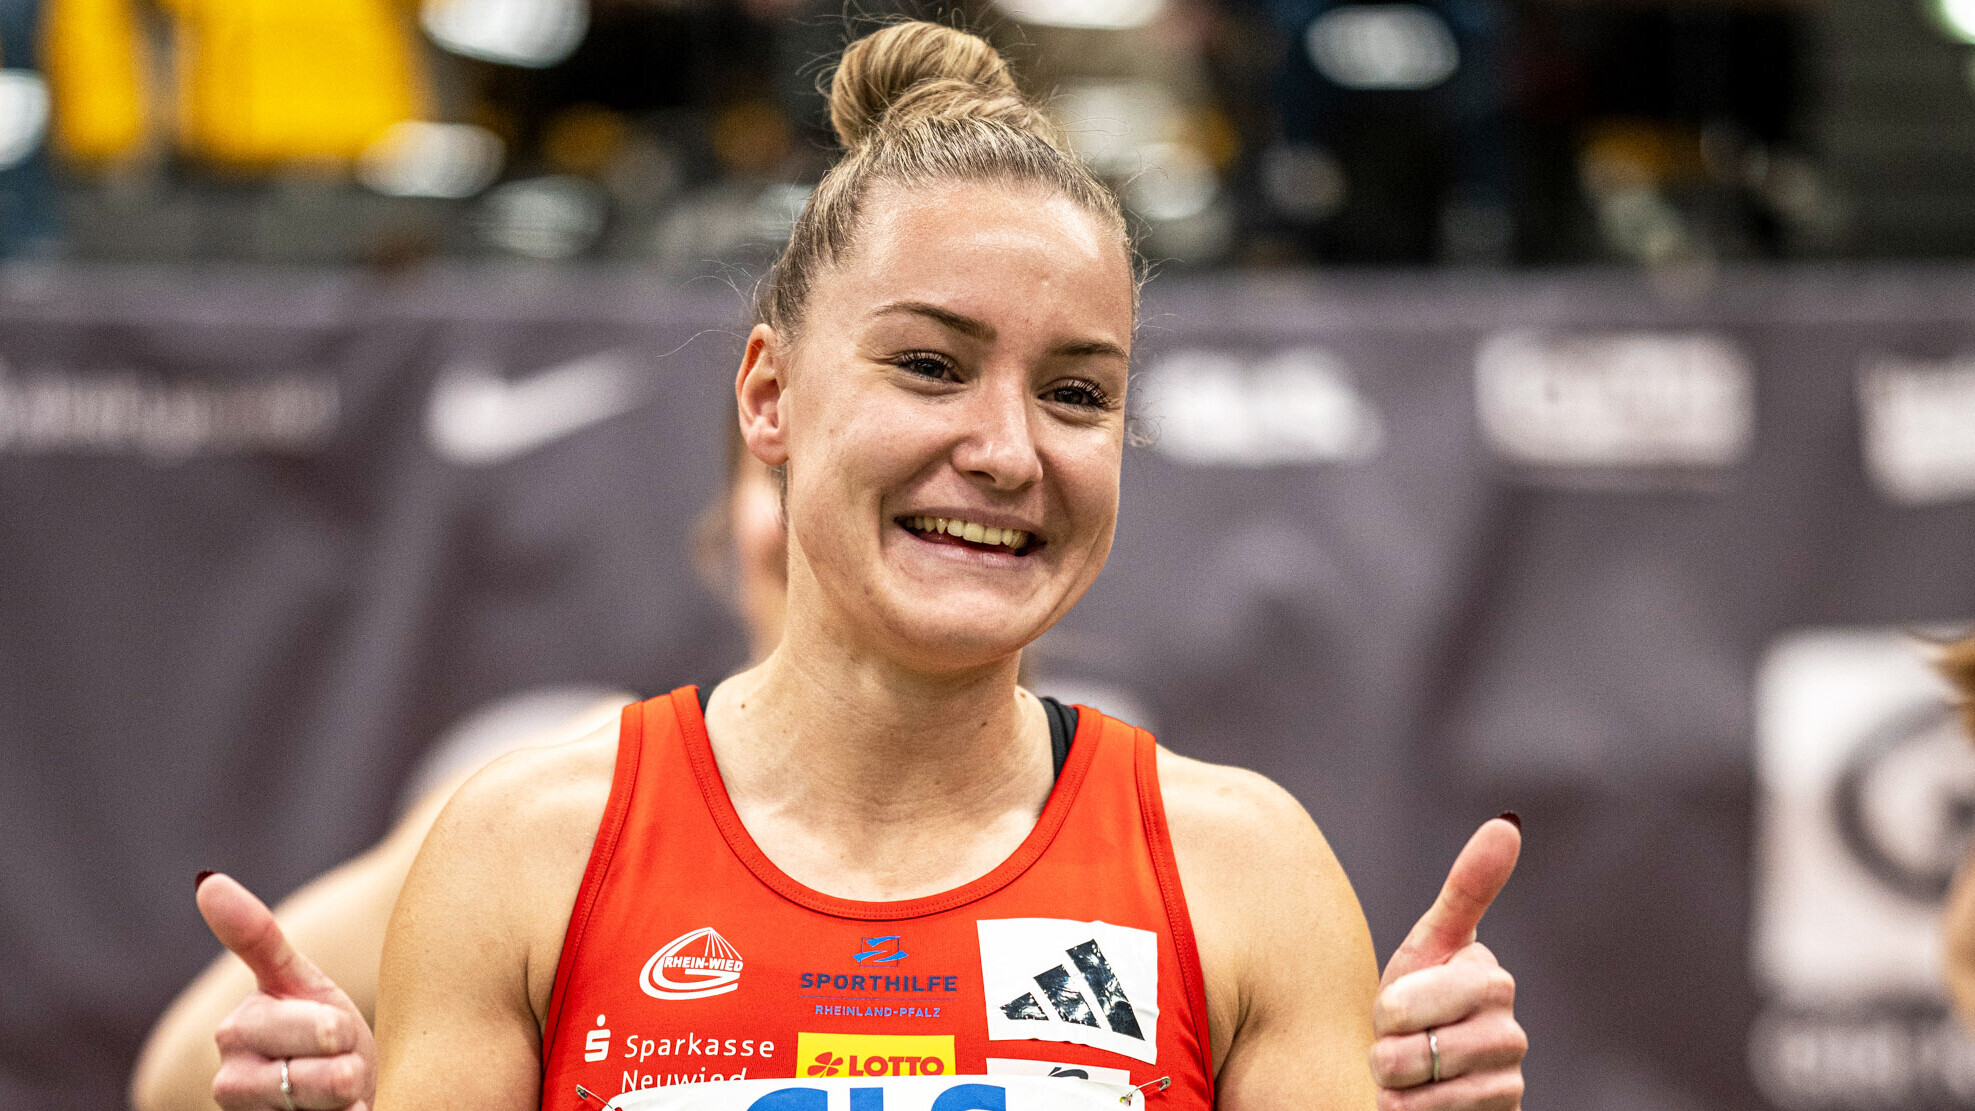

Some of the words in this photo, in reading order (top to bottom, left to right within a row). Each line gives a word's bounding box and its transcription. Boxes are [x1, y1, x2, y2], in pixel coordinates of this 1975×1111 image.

[663, 955, 744, 973] RHEIN-WIED
[800, 972, 958, 992] SPORTHILFE
[814, 1004, 941, 1018] RHEINLAND-PFALZ
[624, 1032, 775, 1063] Sparkasse
[848, 1055, 945, 1077] LOTTO
